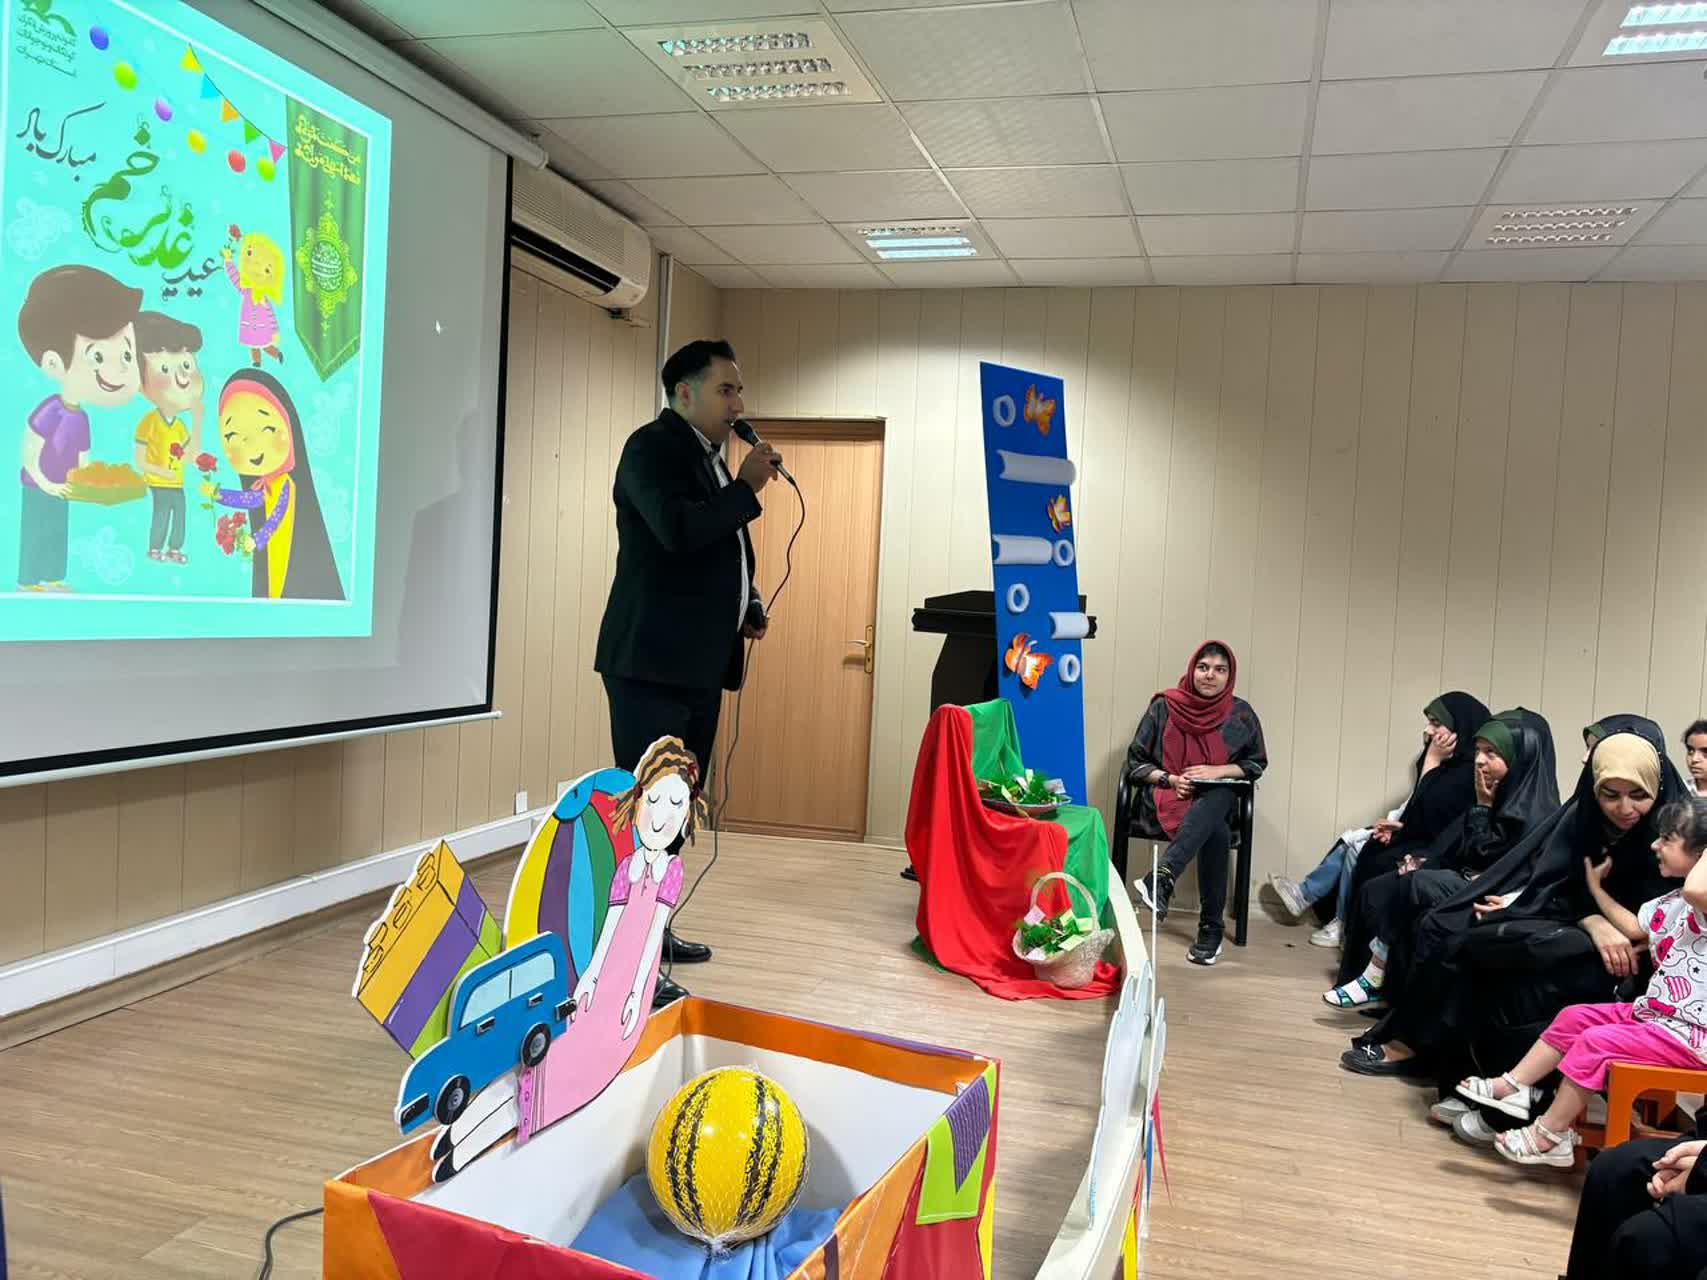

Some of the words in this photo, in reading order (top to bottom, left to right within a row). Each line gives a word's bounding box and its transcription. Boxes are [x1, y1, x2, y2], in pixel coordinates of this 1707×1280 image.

[81, 114, 160, 253] خم
[101, 185, 194, 270] غدیر
[162, 257, 225, 301] عید
